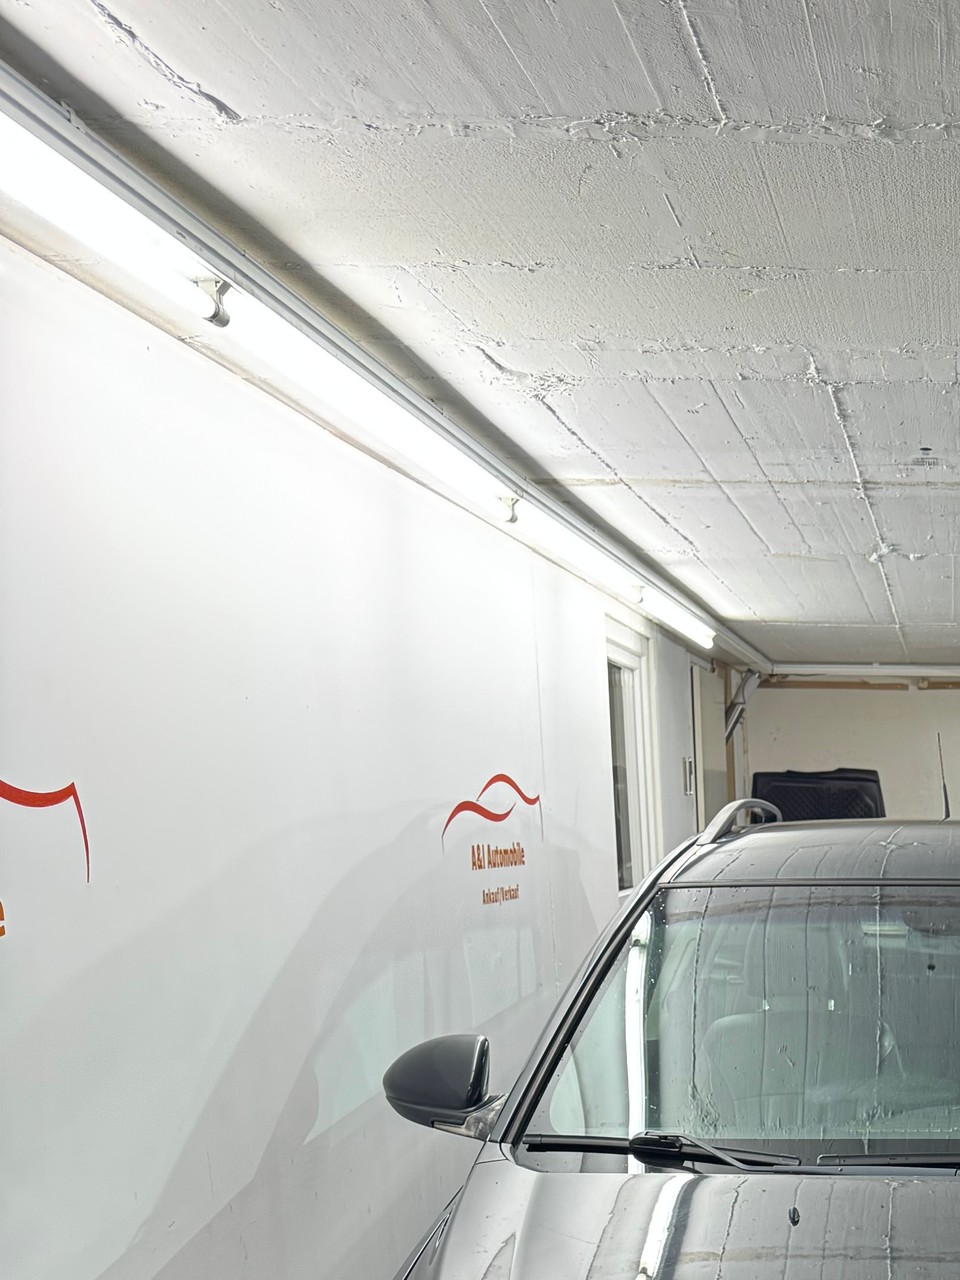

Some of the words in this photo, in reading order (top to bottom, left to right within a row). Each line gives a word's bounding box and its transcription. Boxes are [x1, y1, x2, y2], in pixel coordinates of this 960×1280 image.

[471, 843, 486, 871] A&I
[487, 841, 526, 869] Automobile
[482, 883, 520, 905] Ankauf/Verkauf
